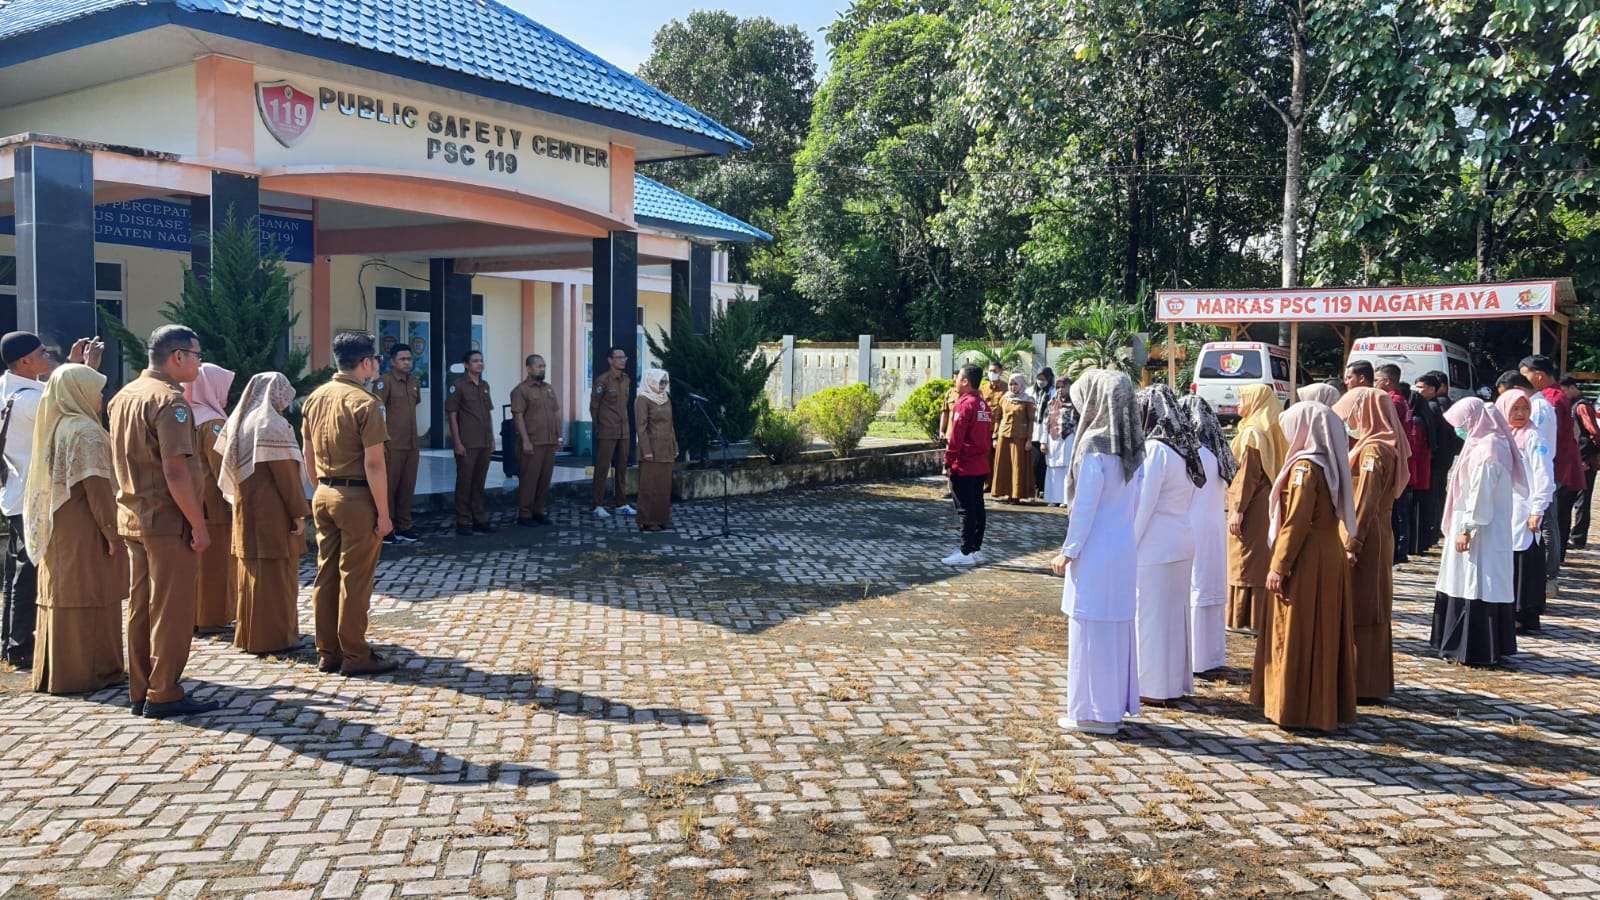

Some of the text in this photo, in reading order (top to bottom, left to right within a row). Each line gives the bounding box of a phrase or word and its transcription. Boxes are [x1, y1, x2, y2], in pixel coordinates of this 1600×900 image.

[270, 98, 307, 127] 119
[319, 86, 609, 168] PUBLIC SAFETY CENTER
[427, 137, 518, 174] PSC 119
[112, 200, 191, 218] PERCEPAT
[119, 213, 184, 230] DISEASE
[158, 230, 192, 244] NAG
[1196, 297, 1274, 315] MARKAS
[1279, 296, 1317, 314] PSC
[1322, 295, 1352, 313] 119
[1358, 294, 1433, 313] NAGAN
[1440, 290, 1501, 311] RAYA
